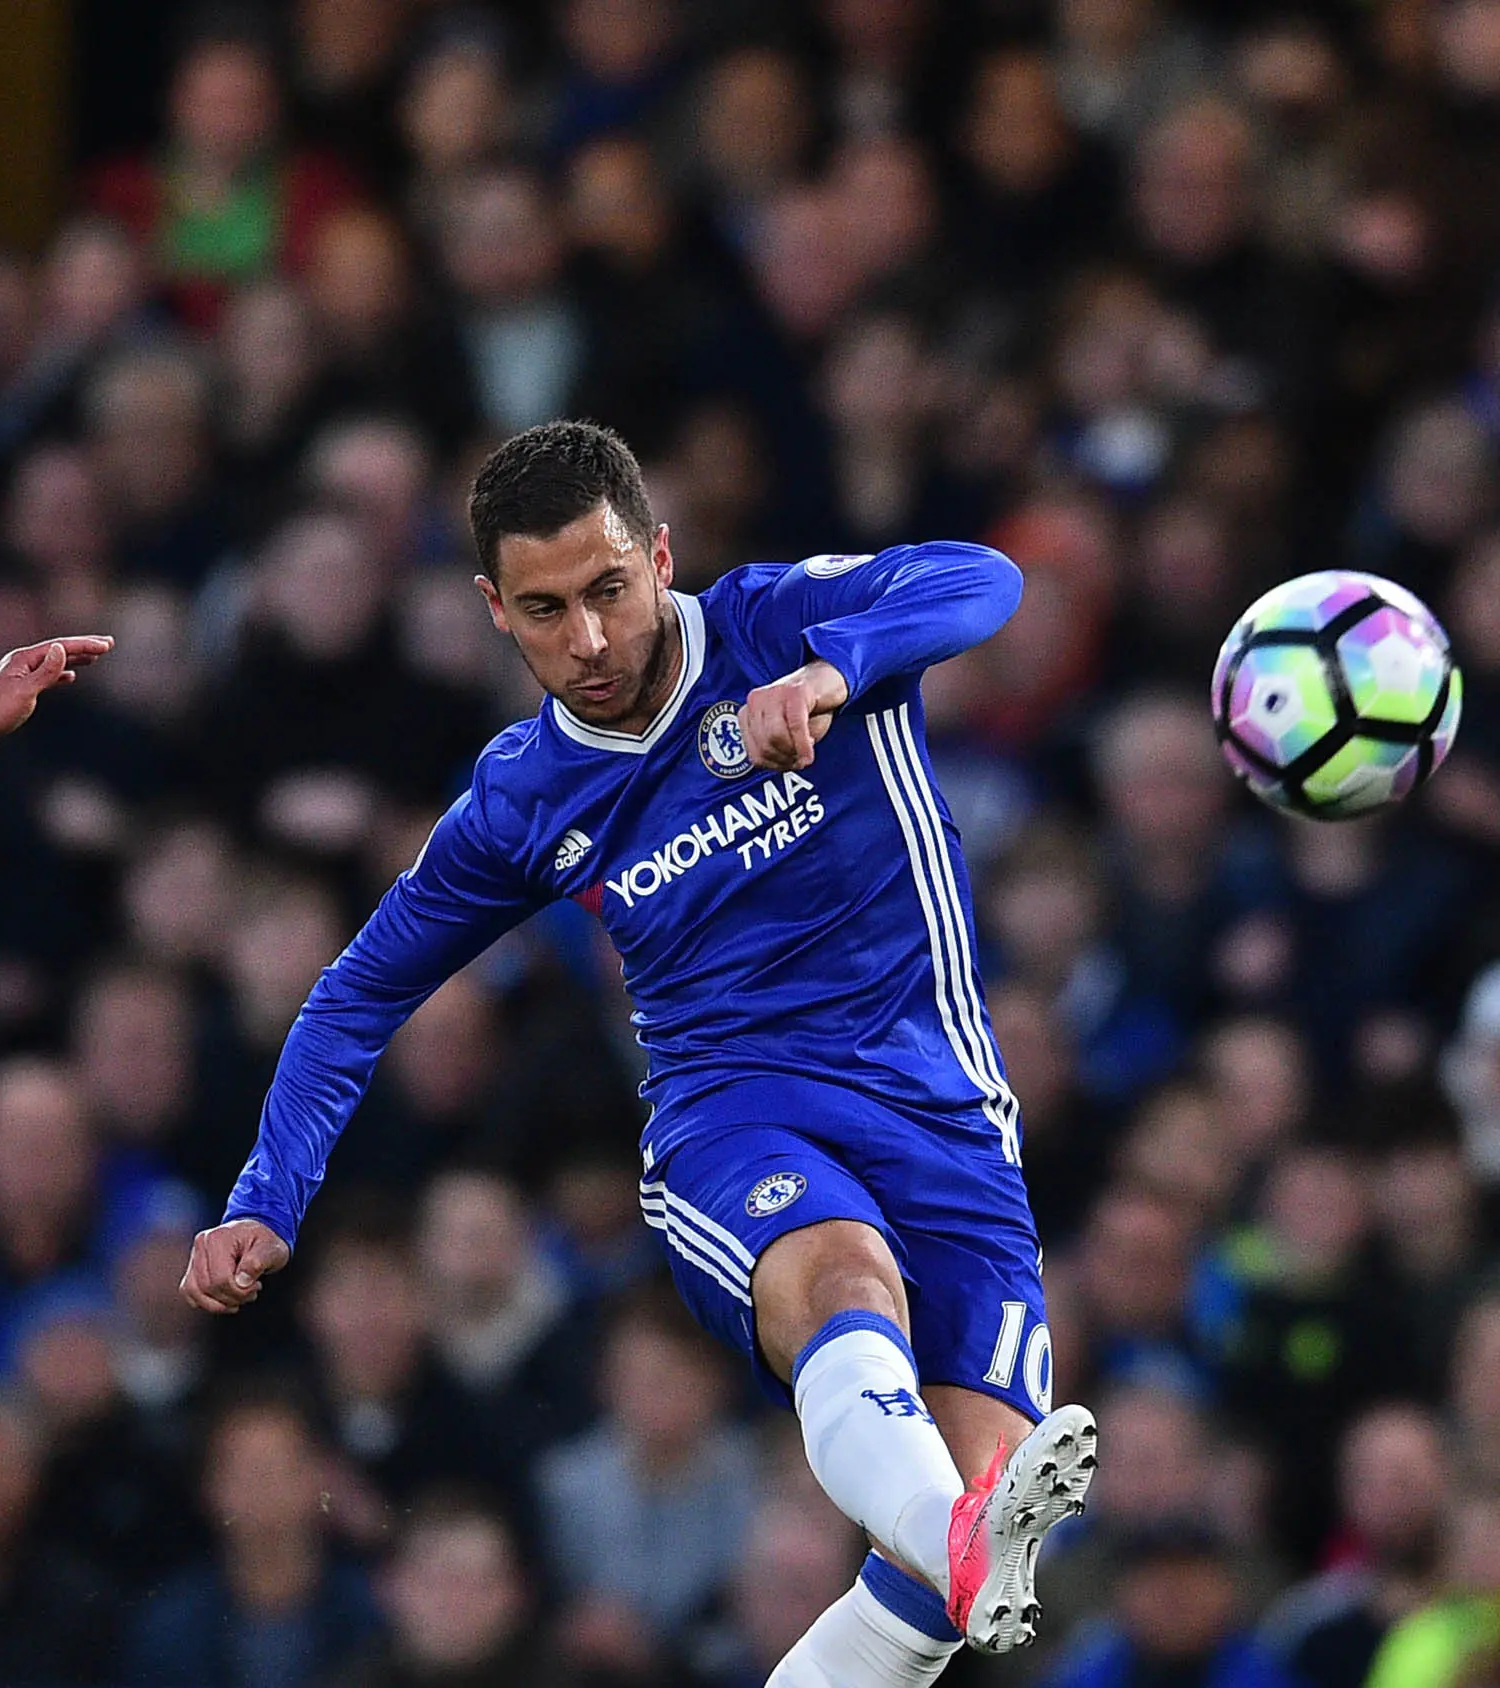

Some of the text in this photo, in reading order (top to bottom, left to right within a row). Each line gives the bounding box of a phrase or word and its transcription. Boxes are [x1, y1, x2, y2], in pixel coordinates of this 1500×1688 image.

[702, 704, 735, 733] CHELSEA
[605, 771, 814, 908] YOKOHAMA
[737, 795, 825, 870] TYRES
[983, 1301, 1053, 1417] 10
